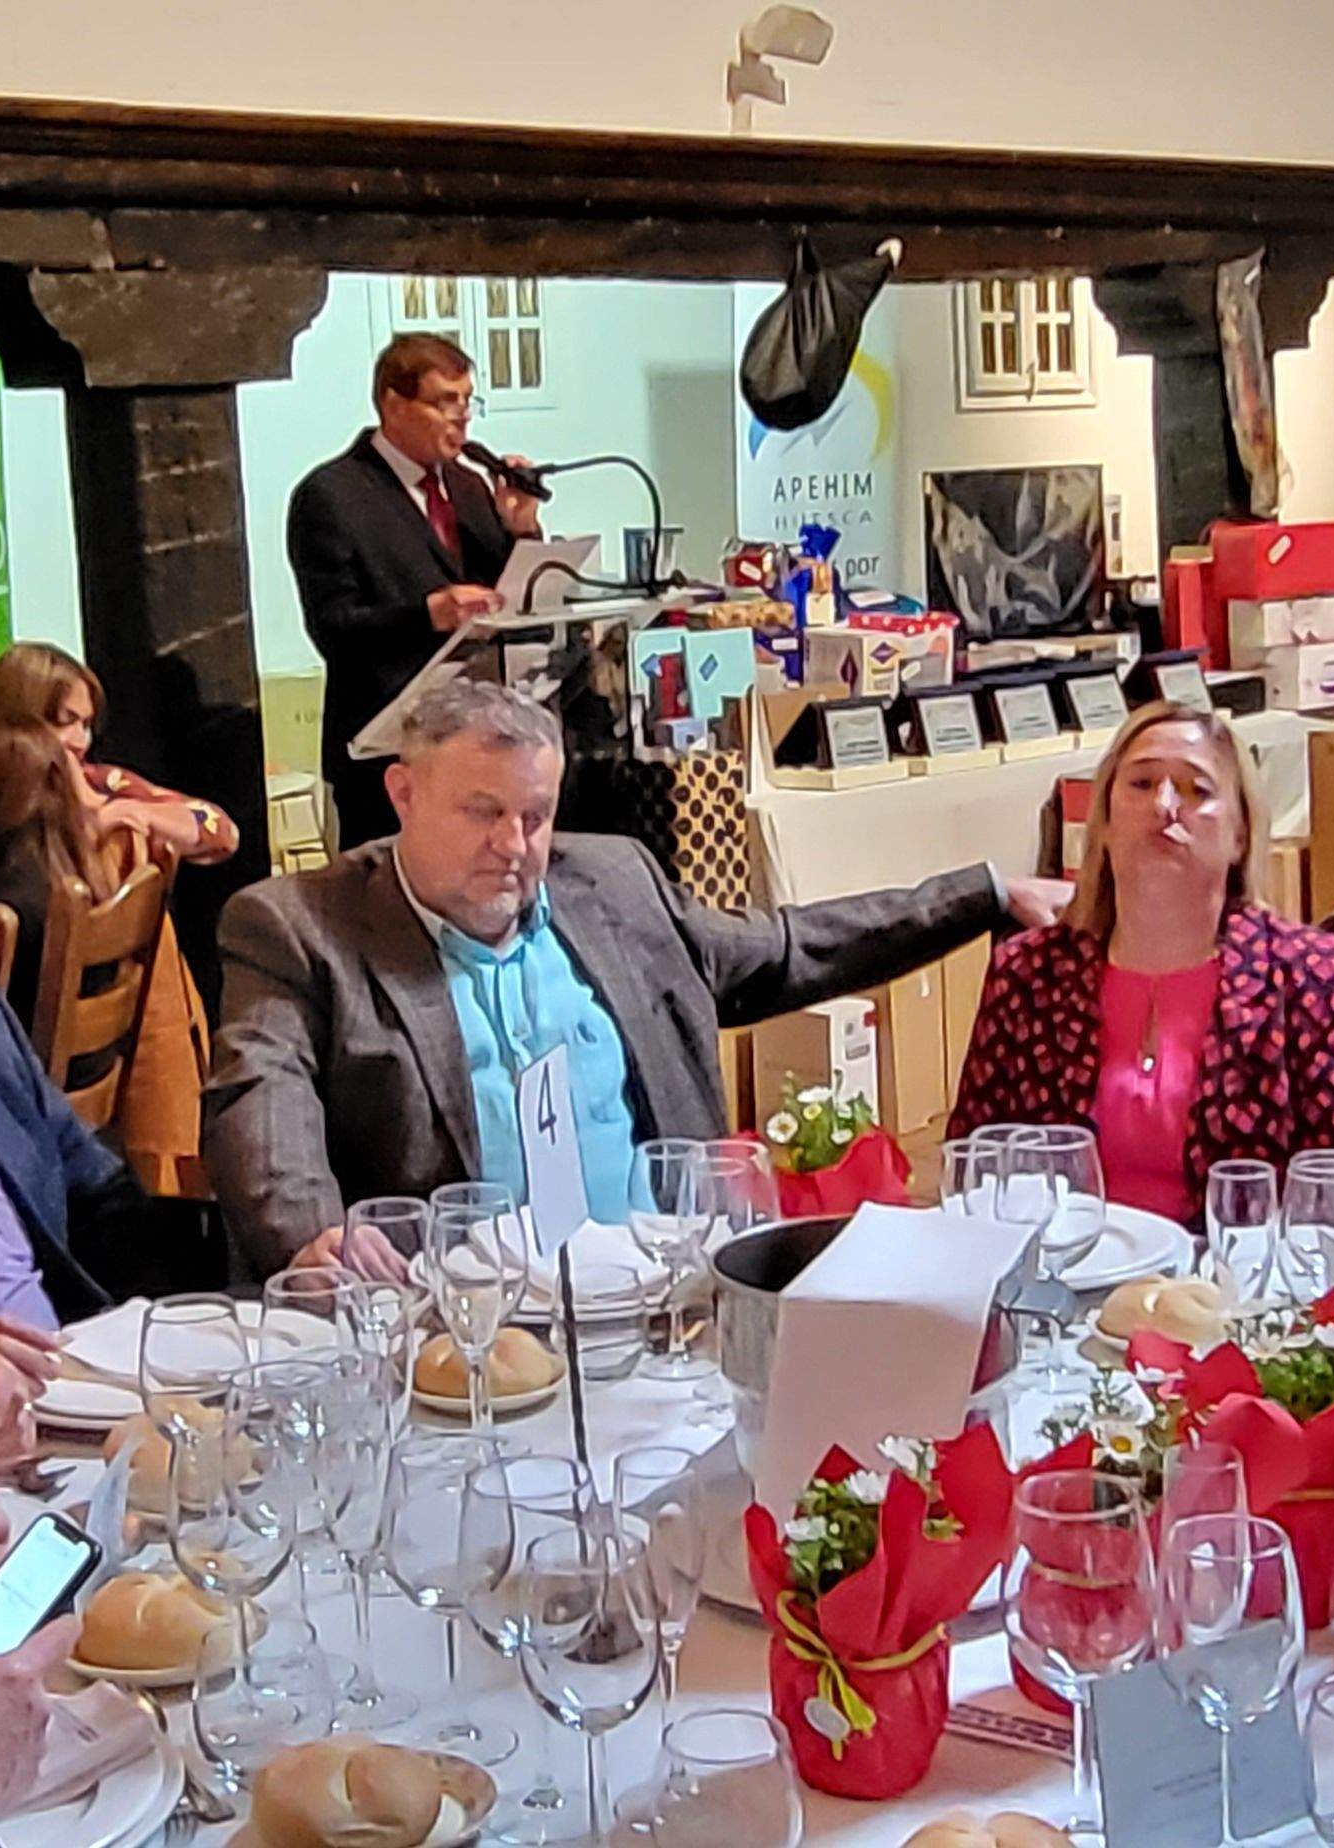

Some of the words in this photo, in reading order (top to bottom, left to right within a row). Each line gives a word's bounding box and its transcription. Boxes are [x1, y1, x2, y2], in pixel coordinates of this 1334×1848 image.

[773, 472, 873, 502] APEHIM
[845, 555, 880, 583] por
[537, 1060, 558, 1146] 4
